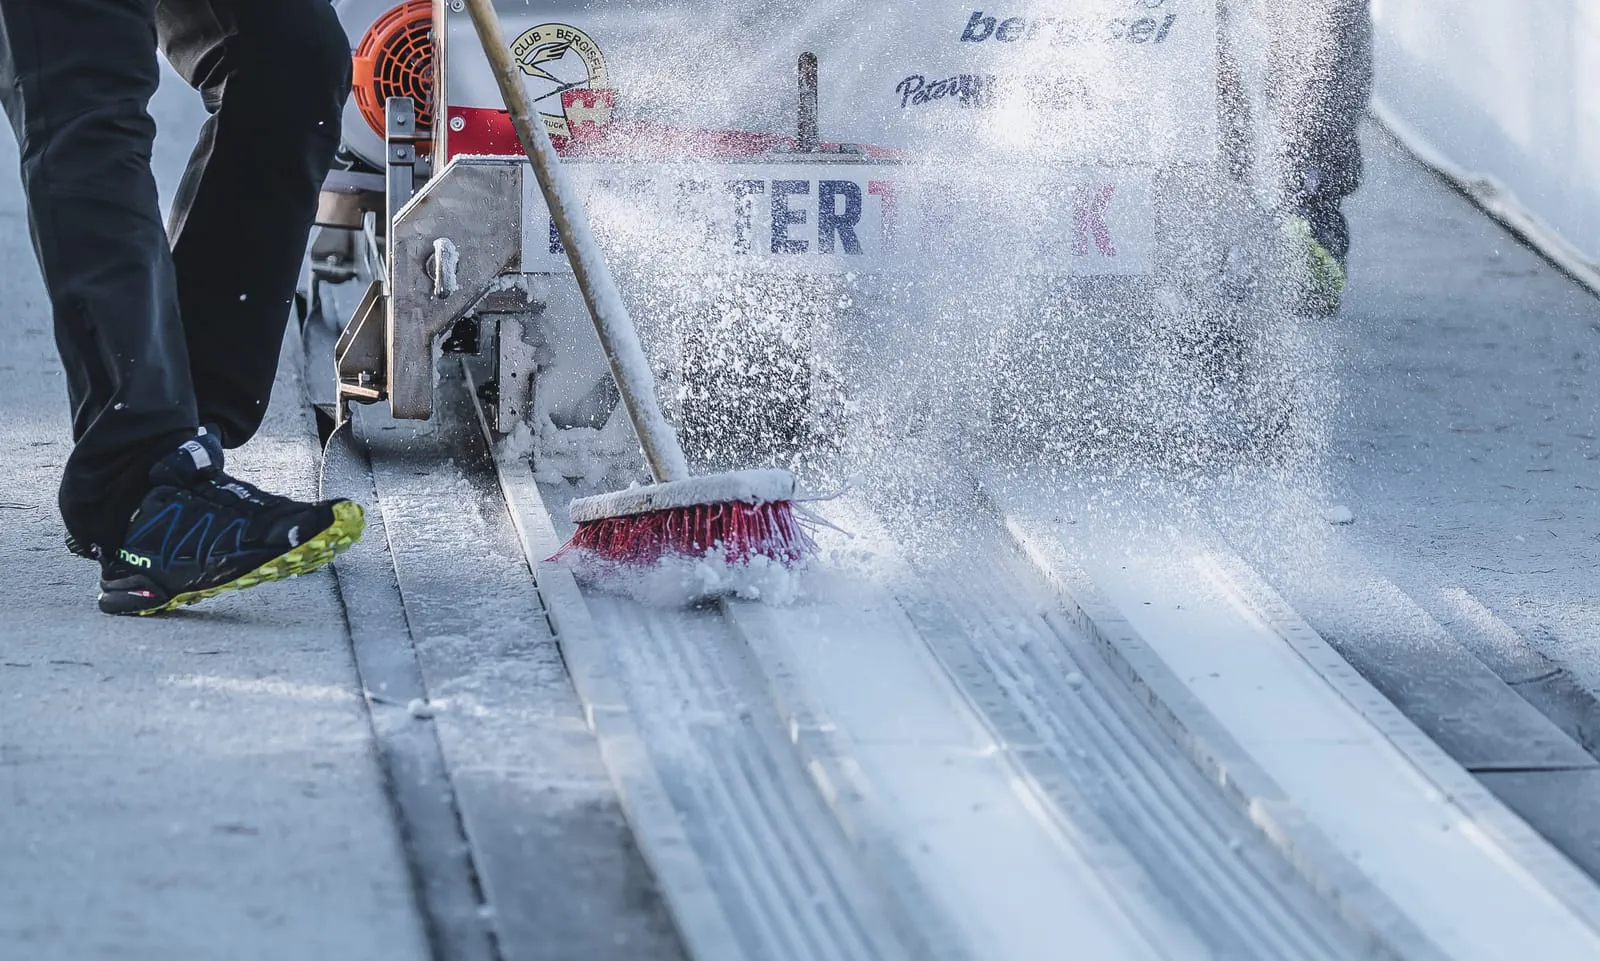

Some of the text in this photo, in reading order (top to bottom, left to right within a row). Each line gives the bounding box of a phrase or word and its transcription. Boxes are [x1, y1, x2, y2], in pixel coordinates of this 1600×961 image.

[960, 11, 1176, 43] bergsel
[514, 31, 542, 57] CLUB
[556, 28, 602, 74] BERGISEL
